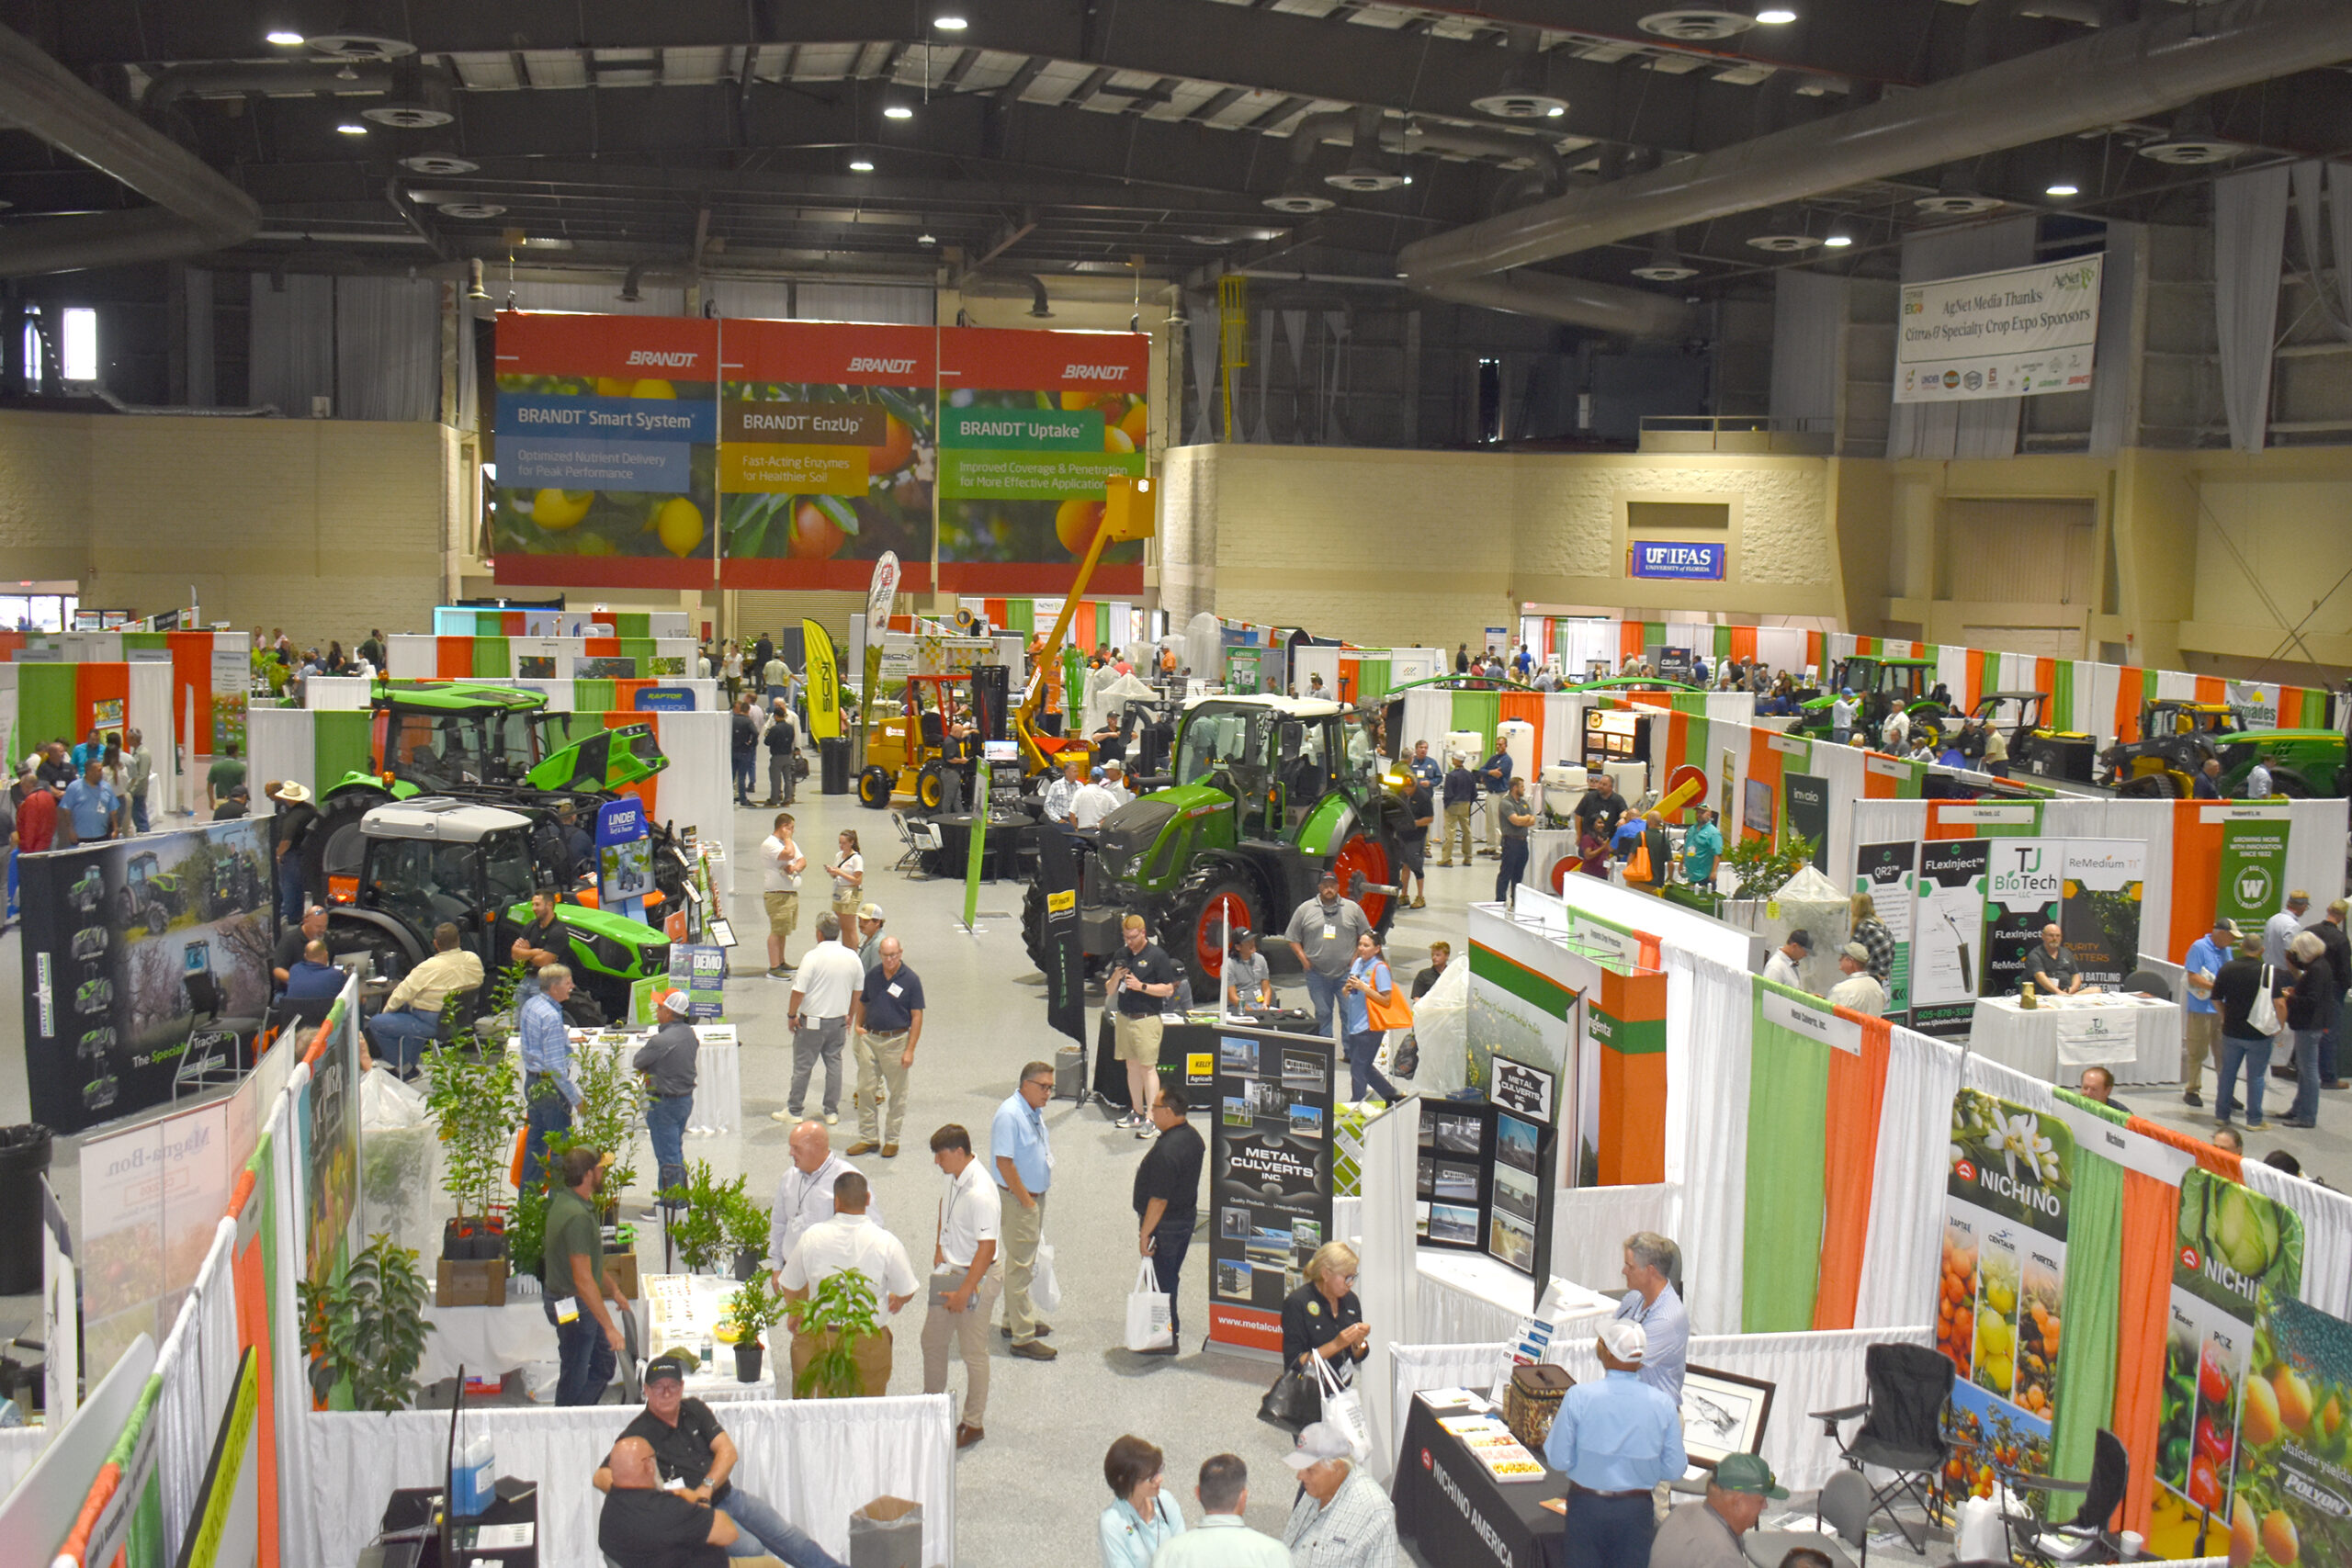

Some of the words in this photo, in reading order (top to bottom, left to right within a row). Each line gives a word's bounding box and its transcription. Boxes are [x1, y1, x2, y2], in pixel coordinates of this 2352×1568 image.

[1943, 299, 1972, 318] AgNet
[1974, 293, 2002, 311] Media
[2005, 289, 2042, 307] Thanks
[1905, 326, 1932, 342] Citrus
[1942, 322, 1984, 342] Specialty
[1986, 319, 2009, 336] Crop
[2012, 315, 2038, 332] Expo
[2041, 308, 2091, 328] Sponsors
[626, 351, 698, 367] BRANDT
[846, 357, 917, 374] BRANDT
[1061, 365, 1129, 380] BRANDT
[589, 412, 633, 427] Smart
[637, 413, 692, 431] System
[813, 417, 860, 435] EnzUp
[1029, 423, 1080, 440] Uptake
[518, 449, 573, 464] Optimized
[575, 451, 619, 464] Nutrient
[622, 452, 667, 468] Delivery
[742, 456, 802, 469] Fast-Acting
[804, 457, 851, 470] Enzymes
[518, 465, 533, 476] for
[536, 466, 562, 477] Peak
[565, 467, 634, 479] Performance
[743, 470, 757, 481] for
[759, 471, 807, 483] Healthier
[809, 472, 827, 483] Soil
[960, 462, 1007, 475] Improved
[1011, 462, 1057, 477] Coverage
[1058, 463, 1067, 474] &
[1069, 464, 1128, 476] Penetration
[960, 476, 974, 487] for
[977, 477, 1001, 488] More
[1004, 477, 1050, 489] Effective
[608, 811, 636, 825] LINDER
[2015, 847, 2041, 873] TJ
[2069, 858, 2124, 868] ReMedium
[1995, 874, 2057, 889] BioTech
[694, 954, 722, 970] DEMO
[2074, 953, 2109, 963] ATTERS
[694, 969, 721, 977] DAY
[2085, 972, 2121, 982] BATTLING
[1589, 1017, 1612, 1038] ngenta
[132, 1055, 150, 1067] The
[1500, 1081, 1540, 1101] CULVERTS
[1508, 1075, 1534, 1090] METAL
[1246, 1147, 1300, 1164] METAL
[1231, 1156, 1314, 1178] CULVERTS
[1261, 1172, 1283, 1182] INC.
[1981, 1167, 2061, 1218] NICHINO
[1230, 1197, 1246, 1206] Quality
[1246, 1199, 1265, 1208] Products
[1297, 1206, 1314, 1215] Service
[1988, 1234, 2015, 1251] CENTAUR
[2205, 1258, 2257, 1303] NICHI
[2281, 1438, 2319, 1467] Juicier
[2284, 1472, 2346, 1514] POLYON
[1433, 1459, 1470, 1518] NICHINO
[1471, 1511, 1513, 1568] AMERICA
